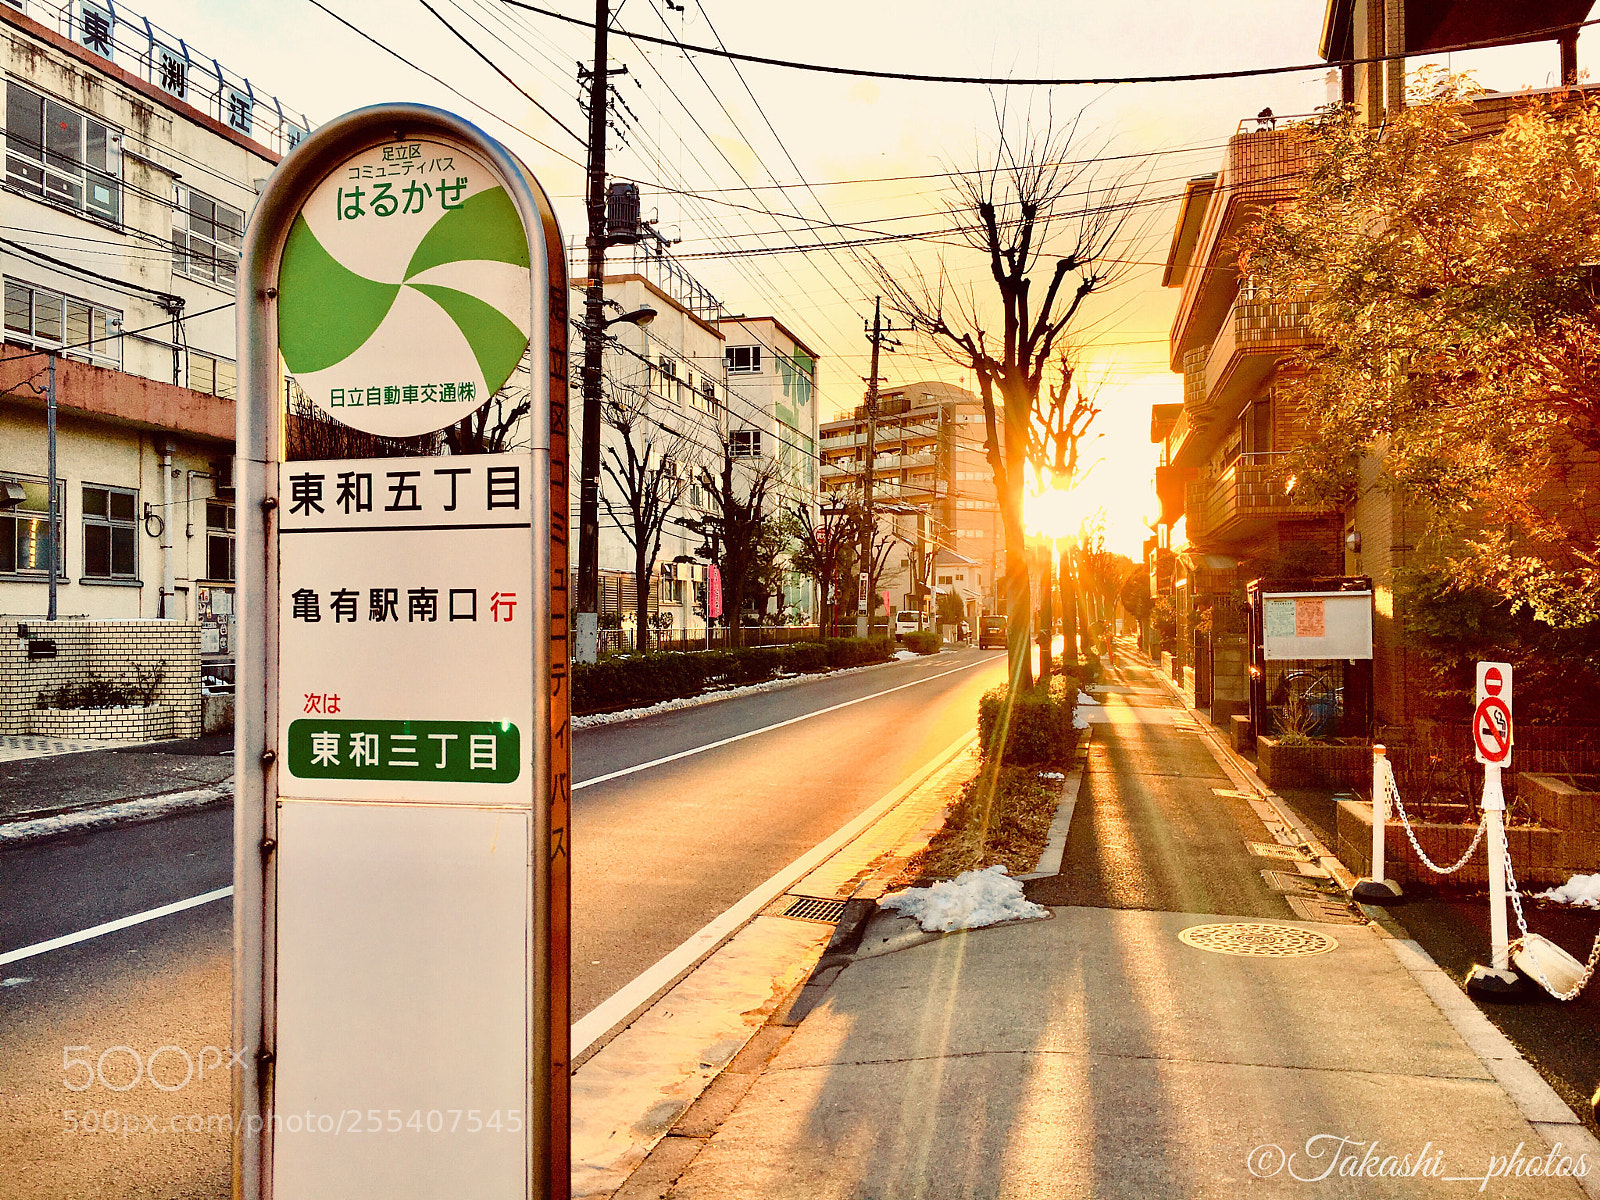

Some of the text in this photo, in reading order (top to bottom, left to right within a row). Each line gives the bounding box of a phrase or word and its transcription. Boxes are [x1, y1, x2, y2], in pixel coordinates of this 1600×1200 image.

[381, 143, 422, 162] 足立区
[348, 157, 456, 180] コミュニティバス
[337, 177, 468, 221] はるかぜ
[289, 466, 520, 516] 東和五丁目
[303, 692, 341, 714] 次は
[310, 731, 497, 770] 東和三丁目
